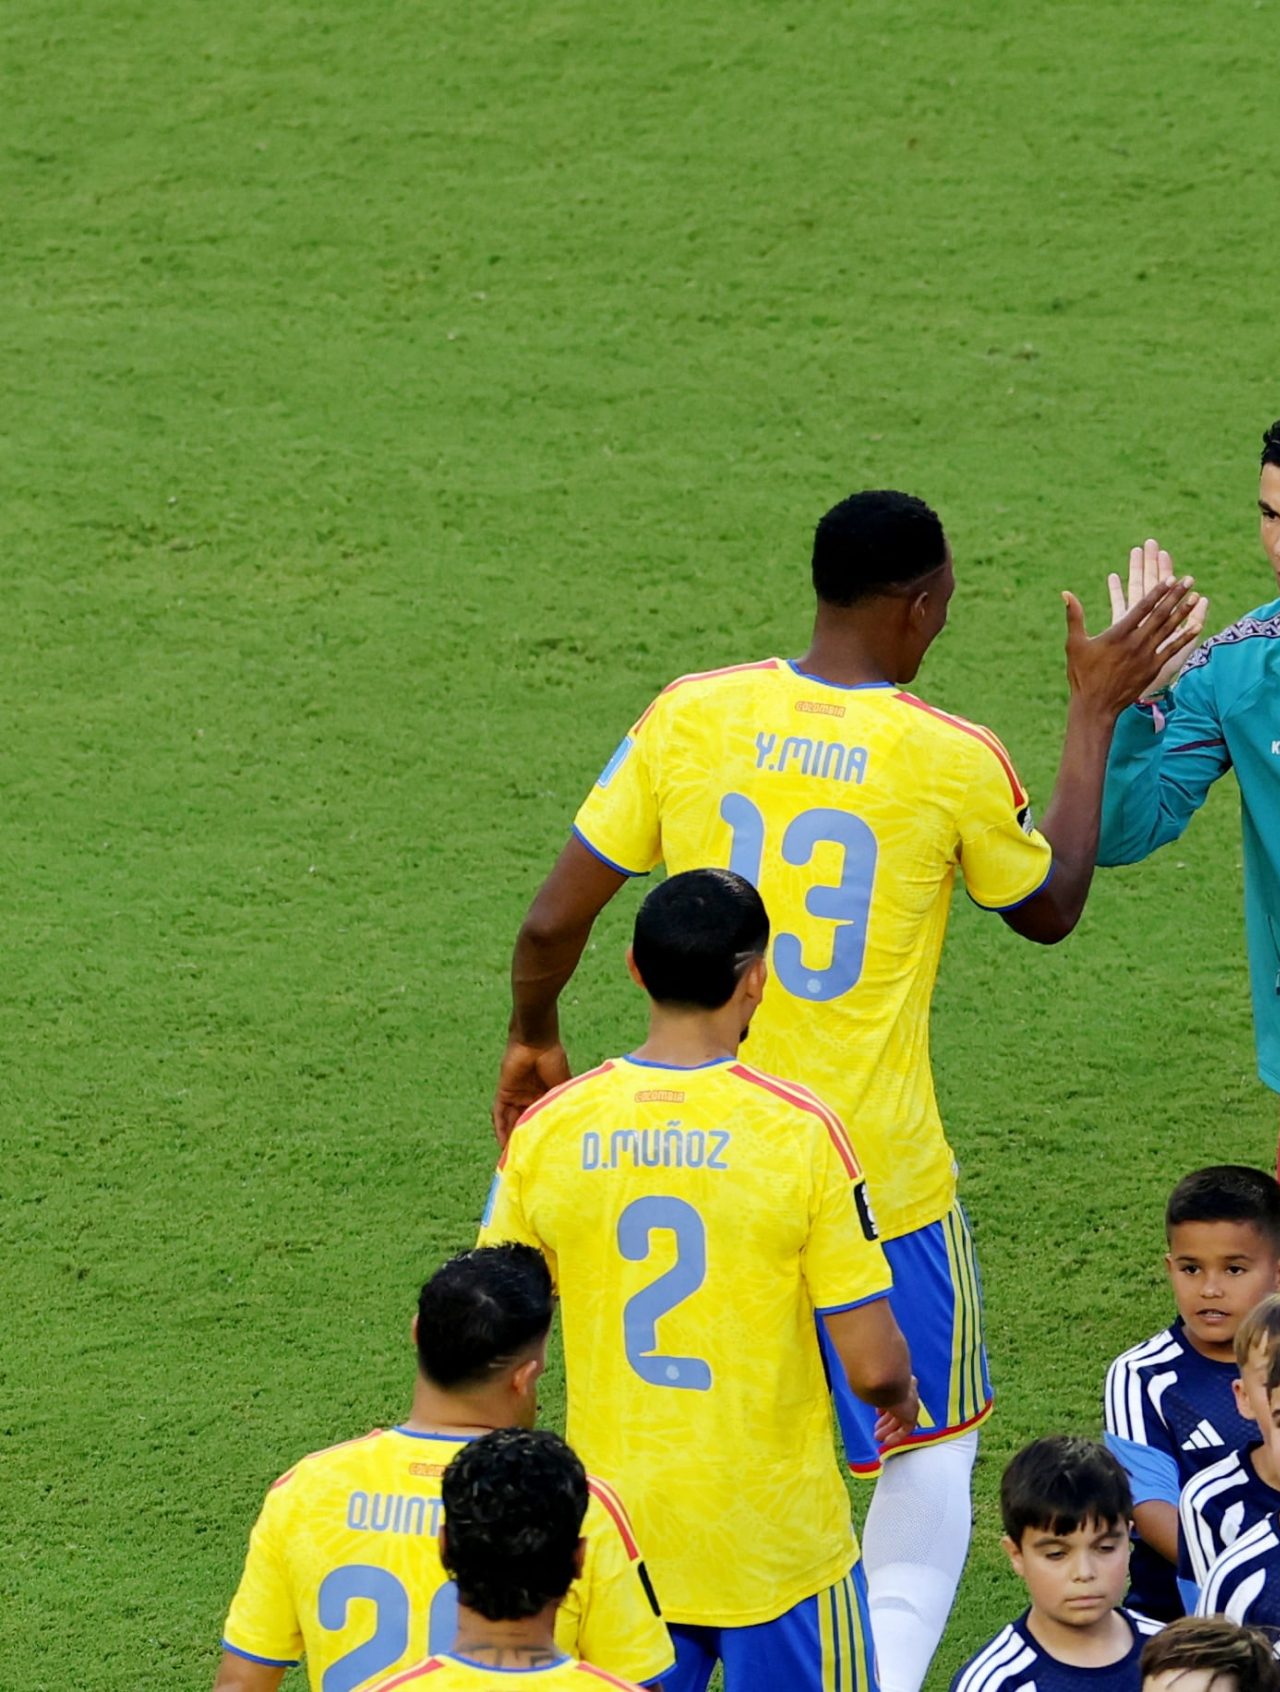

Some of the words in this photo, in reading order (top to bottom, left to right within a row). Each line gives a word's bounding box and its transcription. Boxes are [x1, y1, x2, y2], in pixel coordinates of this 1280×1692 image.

[756, 732, 867, 784] Y.MINA
[720, 792, 878, 1001] 13
[583, 1120, 731, 1170] D.MUÑOZ
[617, 1195, 712, 1391] 2
[318, 1564, 459, 1692] 2
